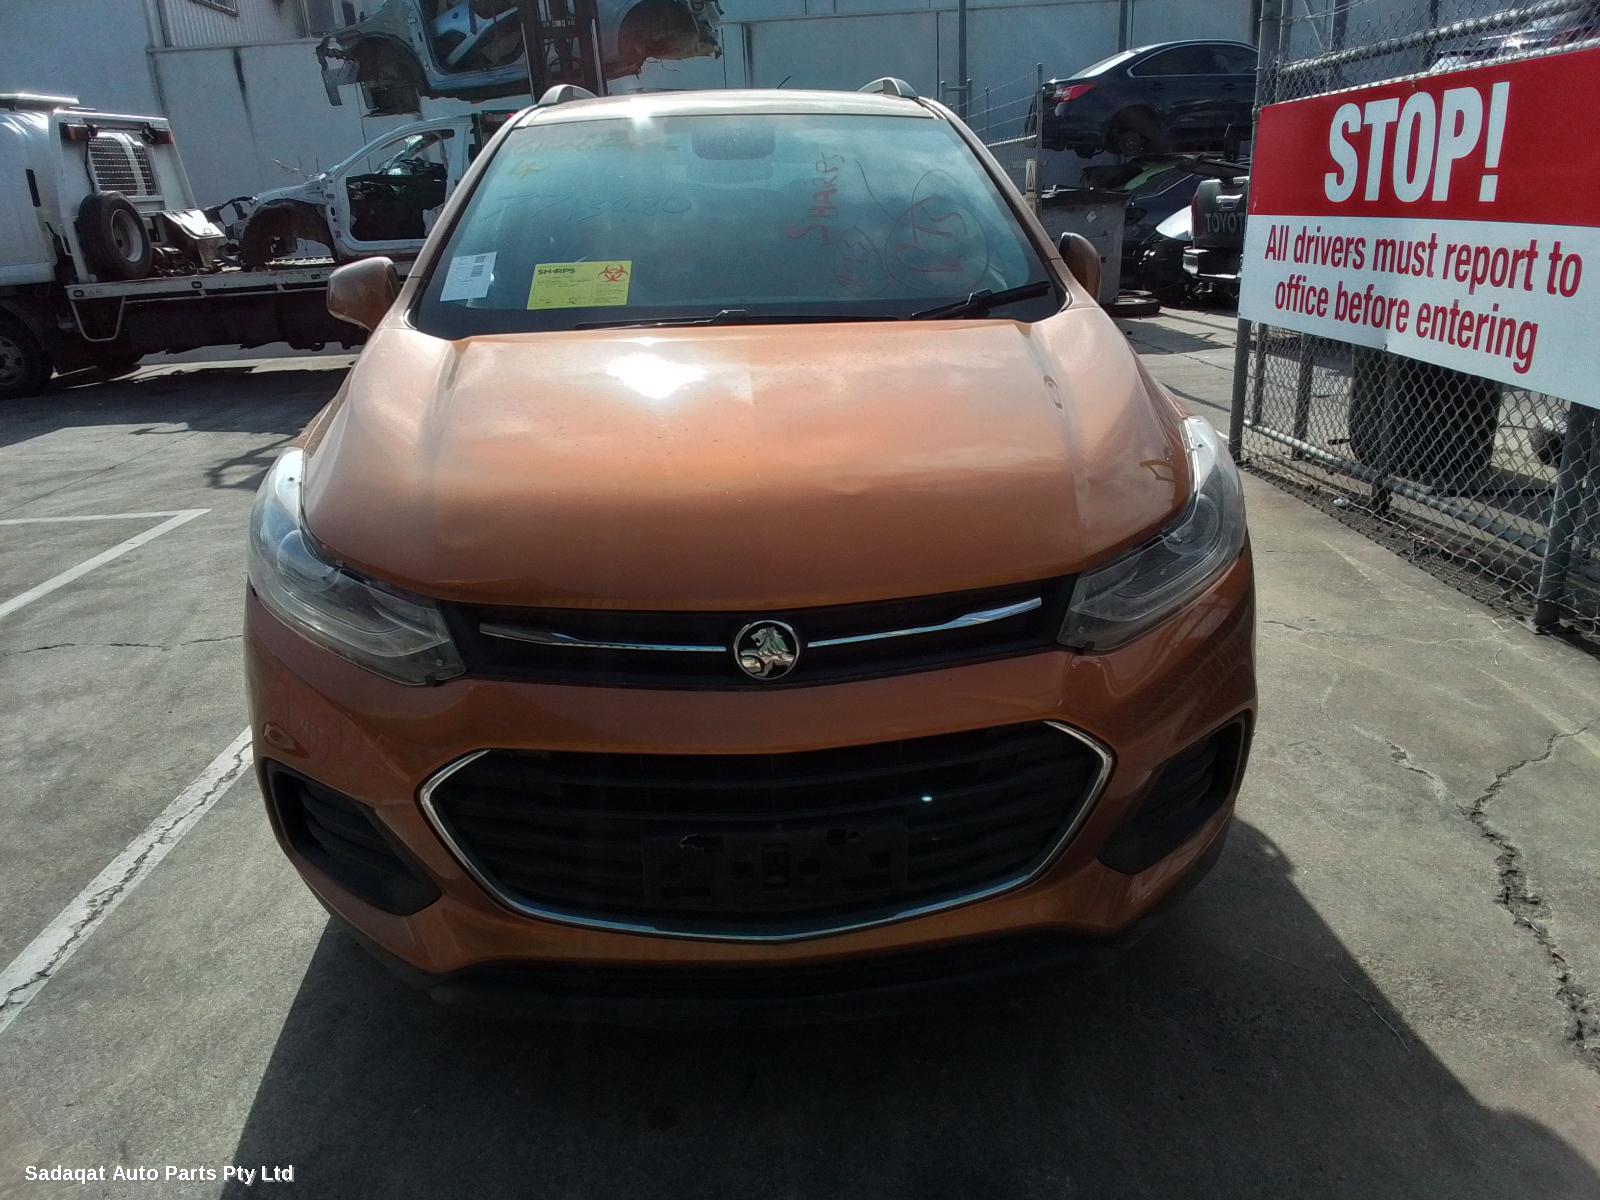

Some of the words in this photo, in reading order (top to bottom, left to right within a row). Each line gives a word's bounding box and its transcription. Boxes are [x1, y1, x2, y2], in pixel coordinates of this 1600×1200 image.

[1324, 81, 1510, 202] STOP!
[1205, 211, 1245, 233] TOYOT
[537, 267, 576, 276] SHARPS
[1264, 224, 1288, 261] All
[1293, 225, 1366, 270] drivers
[1373, 232, 1438, 279] must
[1443, 239, 1539, 296] report
[1547, 241, 1583, 298] to
[1275, 273, 1328, 318] office
[1334, 280, 1409, 333] before
[1416, 302, 1539, 375] entering
